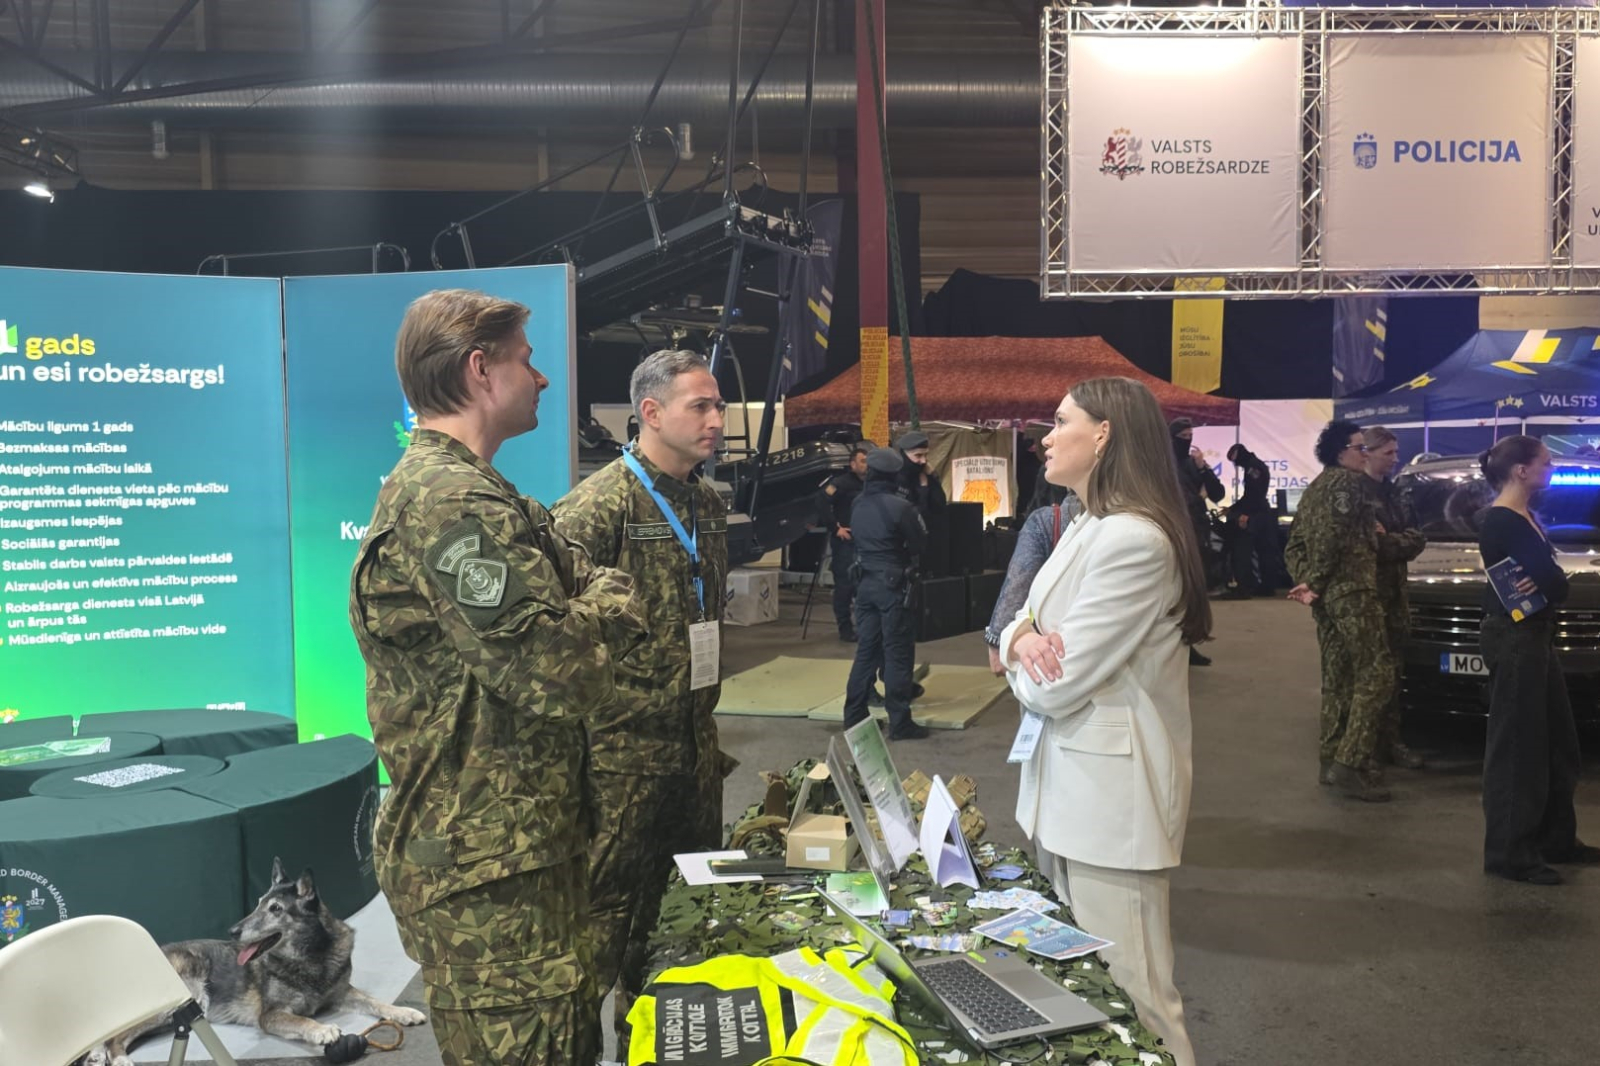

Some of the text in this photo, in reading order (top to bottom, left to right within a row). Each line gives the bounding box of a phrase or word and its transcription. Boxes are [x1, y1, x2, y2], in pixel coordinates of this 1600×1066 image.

[1151, 140, 1212, 153] VALSTS
[1394, 140, 1521, 163] POLICIJA
[1151, 157, 1270, 174] ROBEŽSARDZE
[25, 333, 96, 360] gads
[33, 361, 71, 382] esi
[79, 361, 225, 390] robežsargs!
[1540, 395, 1597, 407] VALSTS
[92, 421, 101, 432] 1
[103, 421, 134, 435] gads
[72, 442, 127, 453] mācības
[773, 448, 805, 465] 2218
[0, 463, 153, 477] Atalgojums mācību laikā
[0, 482, 229, 496] Garantēta dienesta vieta pēc mācību
[0, 496, 197, 511] programmas sekmīgas apguves
[0, 515, 123, 530] Izaugsmes iespējas
[1, 536, 120, 550] Sociālās garantijas
[2, 552, 233, 571] Stabils darbs valsts pārvaldes iestādē
[4, 575, 238, 593] Aizraujošs un efektīvs mācību process
[5, 601, 80, 614] Robežsarga
[137, 595, 163, 607] visā
[164, 593, 205, 607] Latvijā
[8, 614, 87, 629] un ārpus tās
[8, 623, 227, 646] Mūsdienīga un attīstīta mācību vide
[1455, 655, 1483, 673] MO
[10, 868, 48, 886] BORDER
[47, 884, 68, 921] MANAGE
